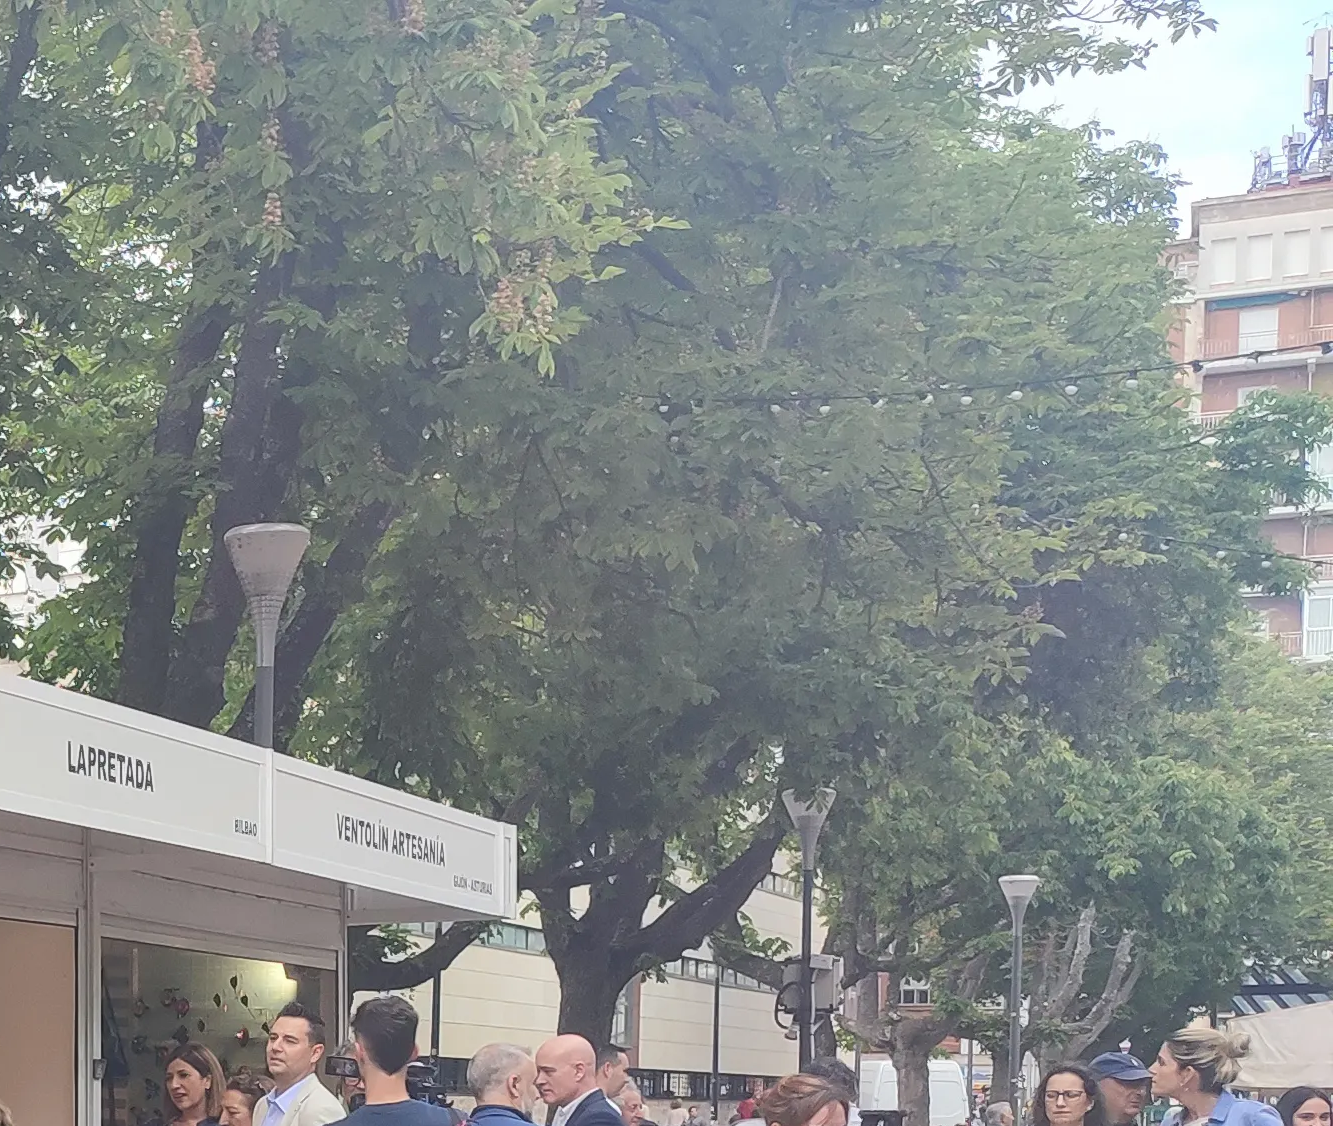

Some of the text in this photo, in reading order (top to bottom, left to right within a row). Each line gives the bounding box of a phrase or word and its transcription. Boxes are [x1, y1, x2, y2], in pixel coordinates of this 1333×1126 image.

[67, 740, 155, 792] LAPRETADA
[234, 819, 258, 837] BILBAO
[336, 813, 446, 867] VENTOLÍN ARTESANÍA
